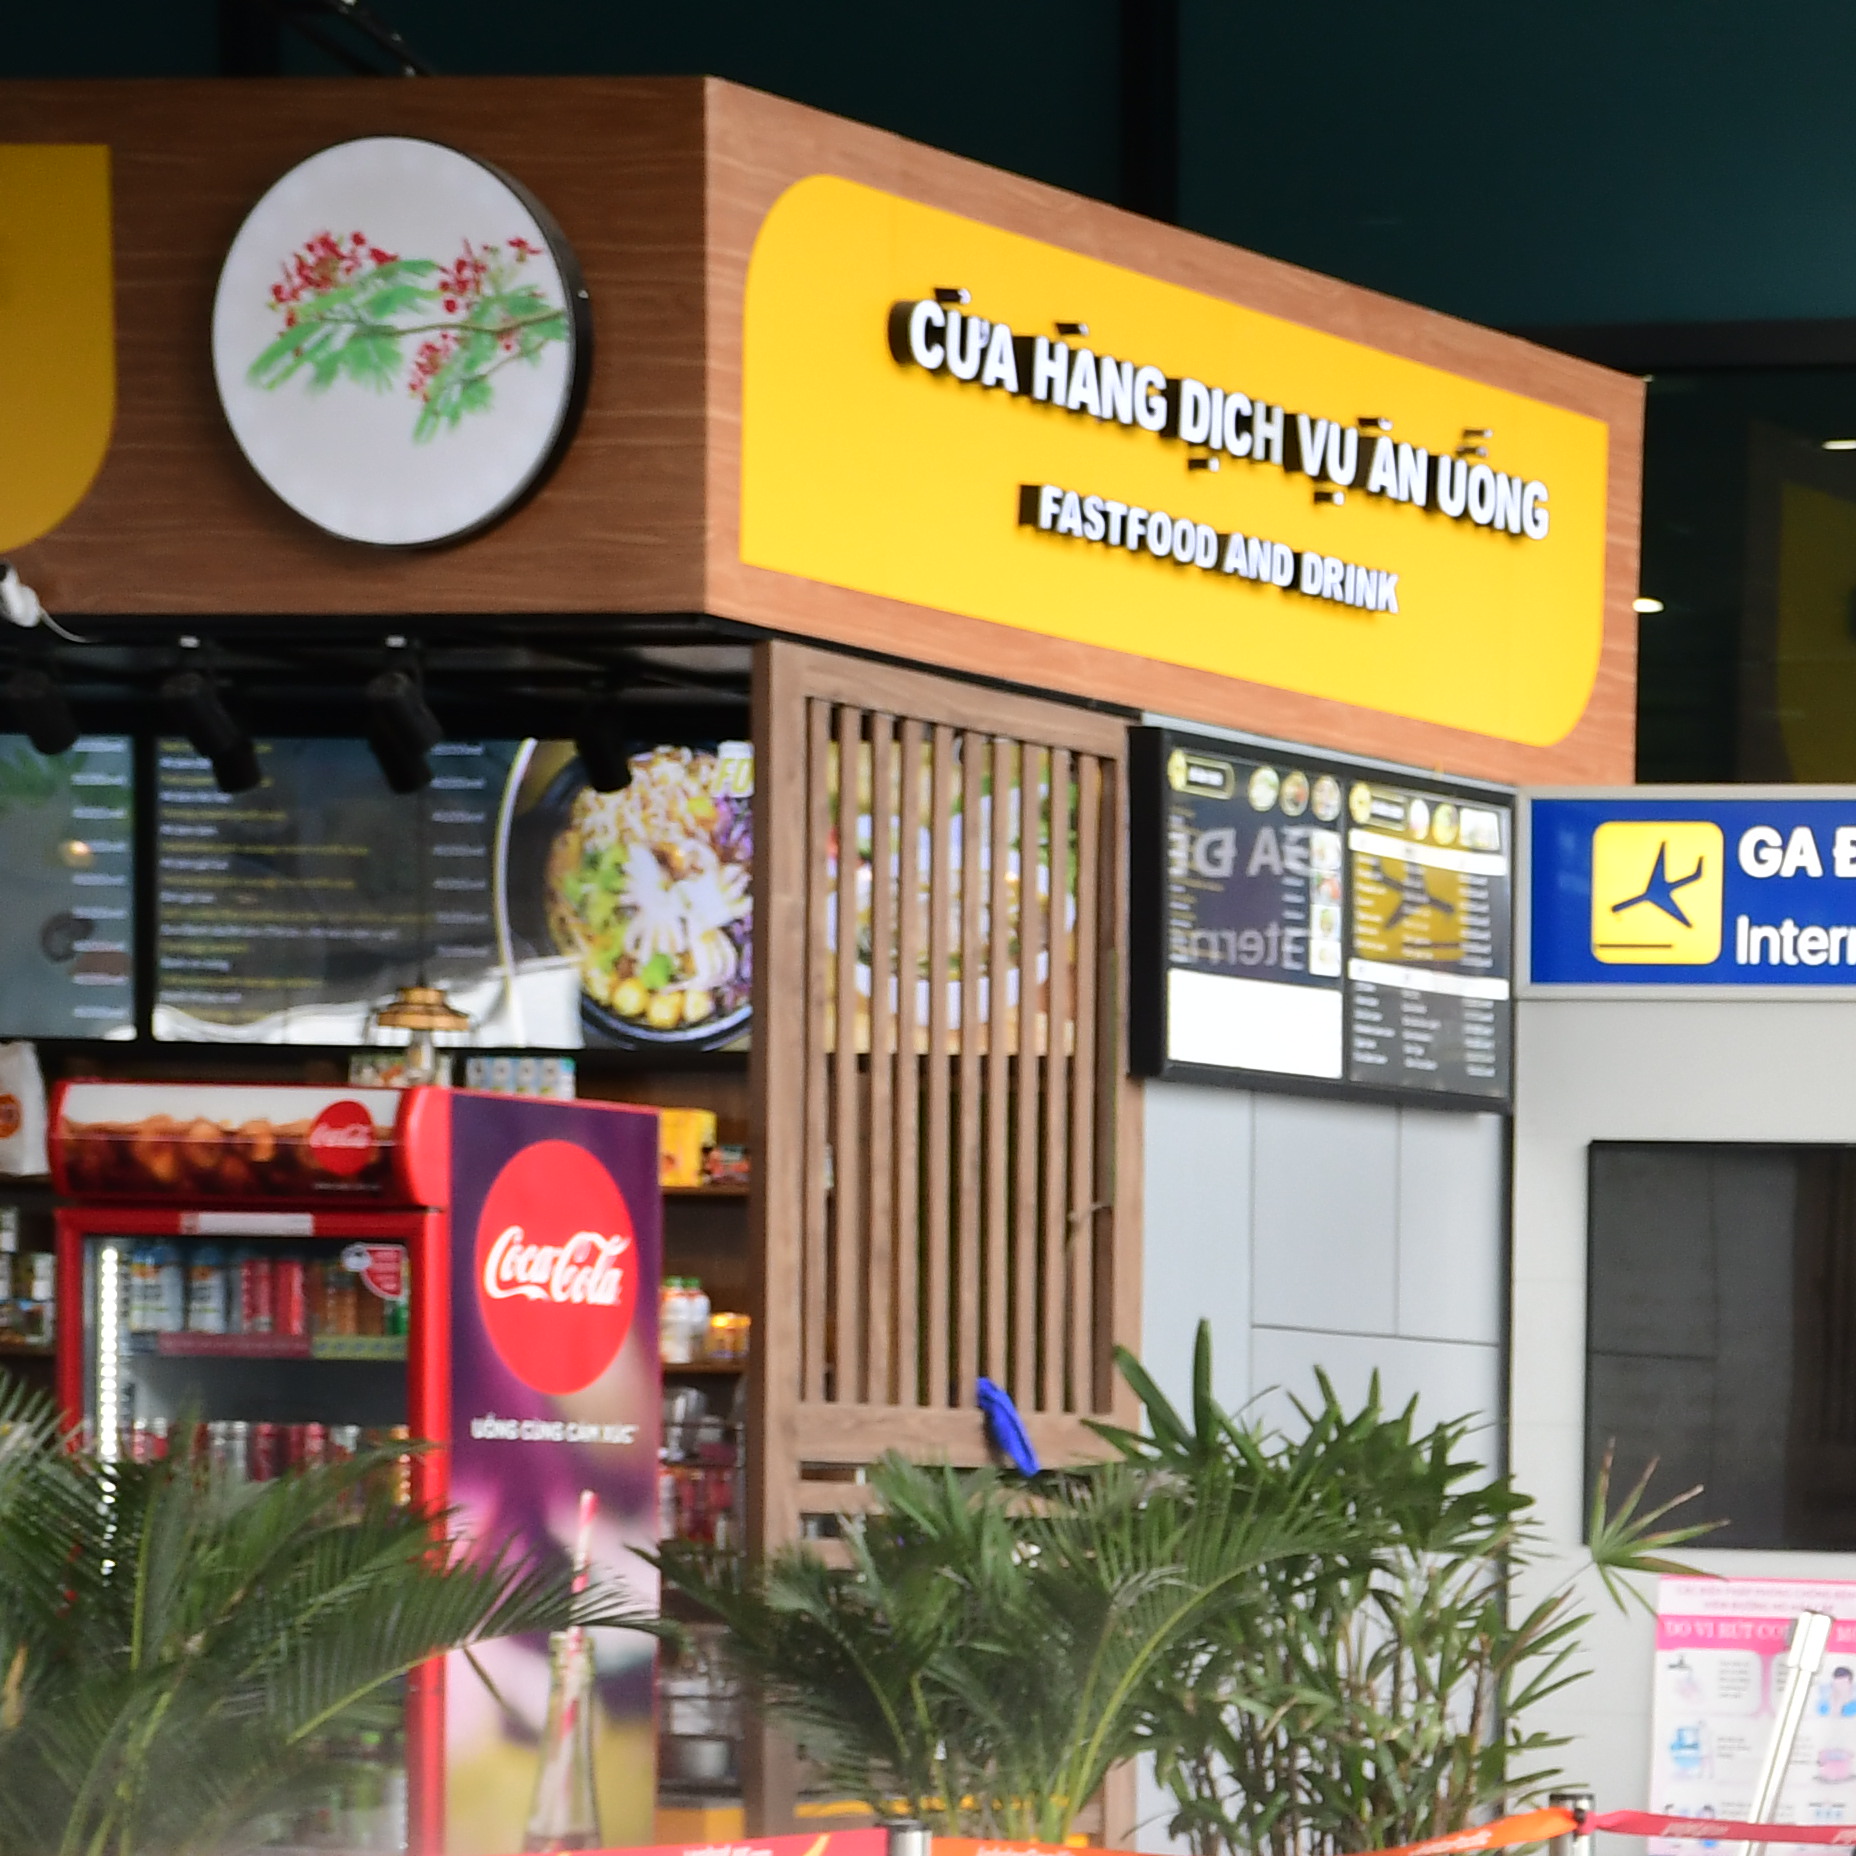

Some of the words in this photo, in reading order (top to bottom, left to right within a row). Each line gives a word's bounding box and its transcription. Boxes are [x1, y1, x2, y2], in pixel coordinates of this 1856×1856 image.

[1032, 321, 1169, 432] HÀNG
[1177, 377, 1286, 473] DỊCH
[1296, 411, 1360, 506] VỤ
[1037, 483, 1219, 570] FASTFOOD
[1222, 531, 1295, 589] AND
[1299, 550, 1400, 615] DRINK
[1736, 826, 1825, 879] GA
[483, 1224, 632, 1306] Coca-Cola
